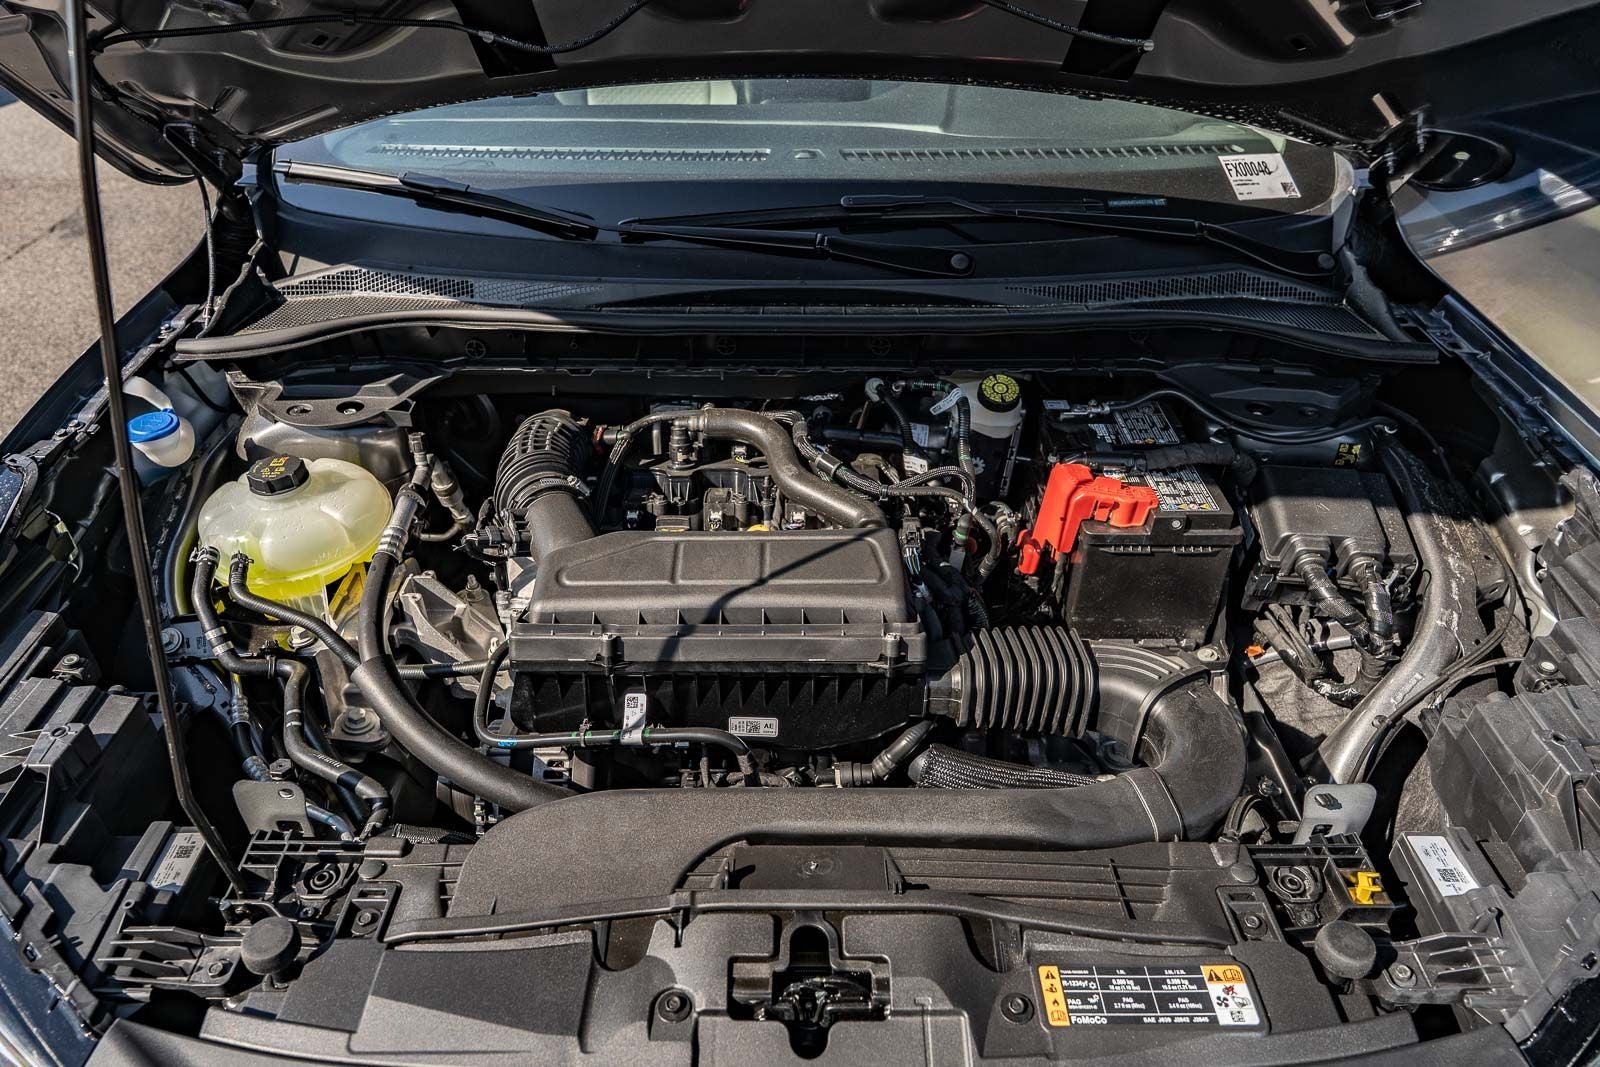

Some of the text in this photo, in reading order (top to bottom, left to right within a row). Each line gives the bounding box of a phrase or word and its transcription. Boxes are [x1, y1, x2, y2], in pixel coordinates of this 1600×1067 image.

[1225, 161, 1271, 177] FX00048
[1062, 980, 1088, 988] R-1234yf
[1071, 1016, 1108, 1024] FoMoCo
